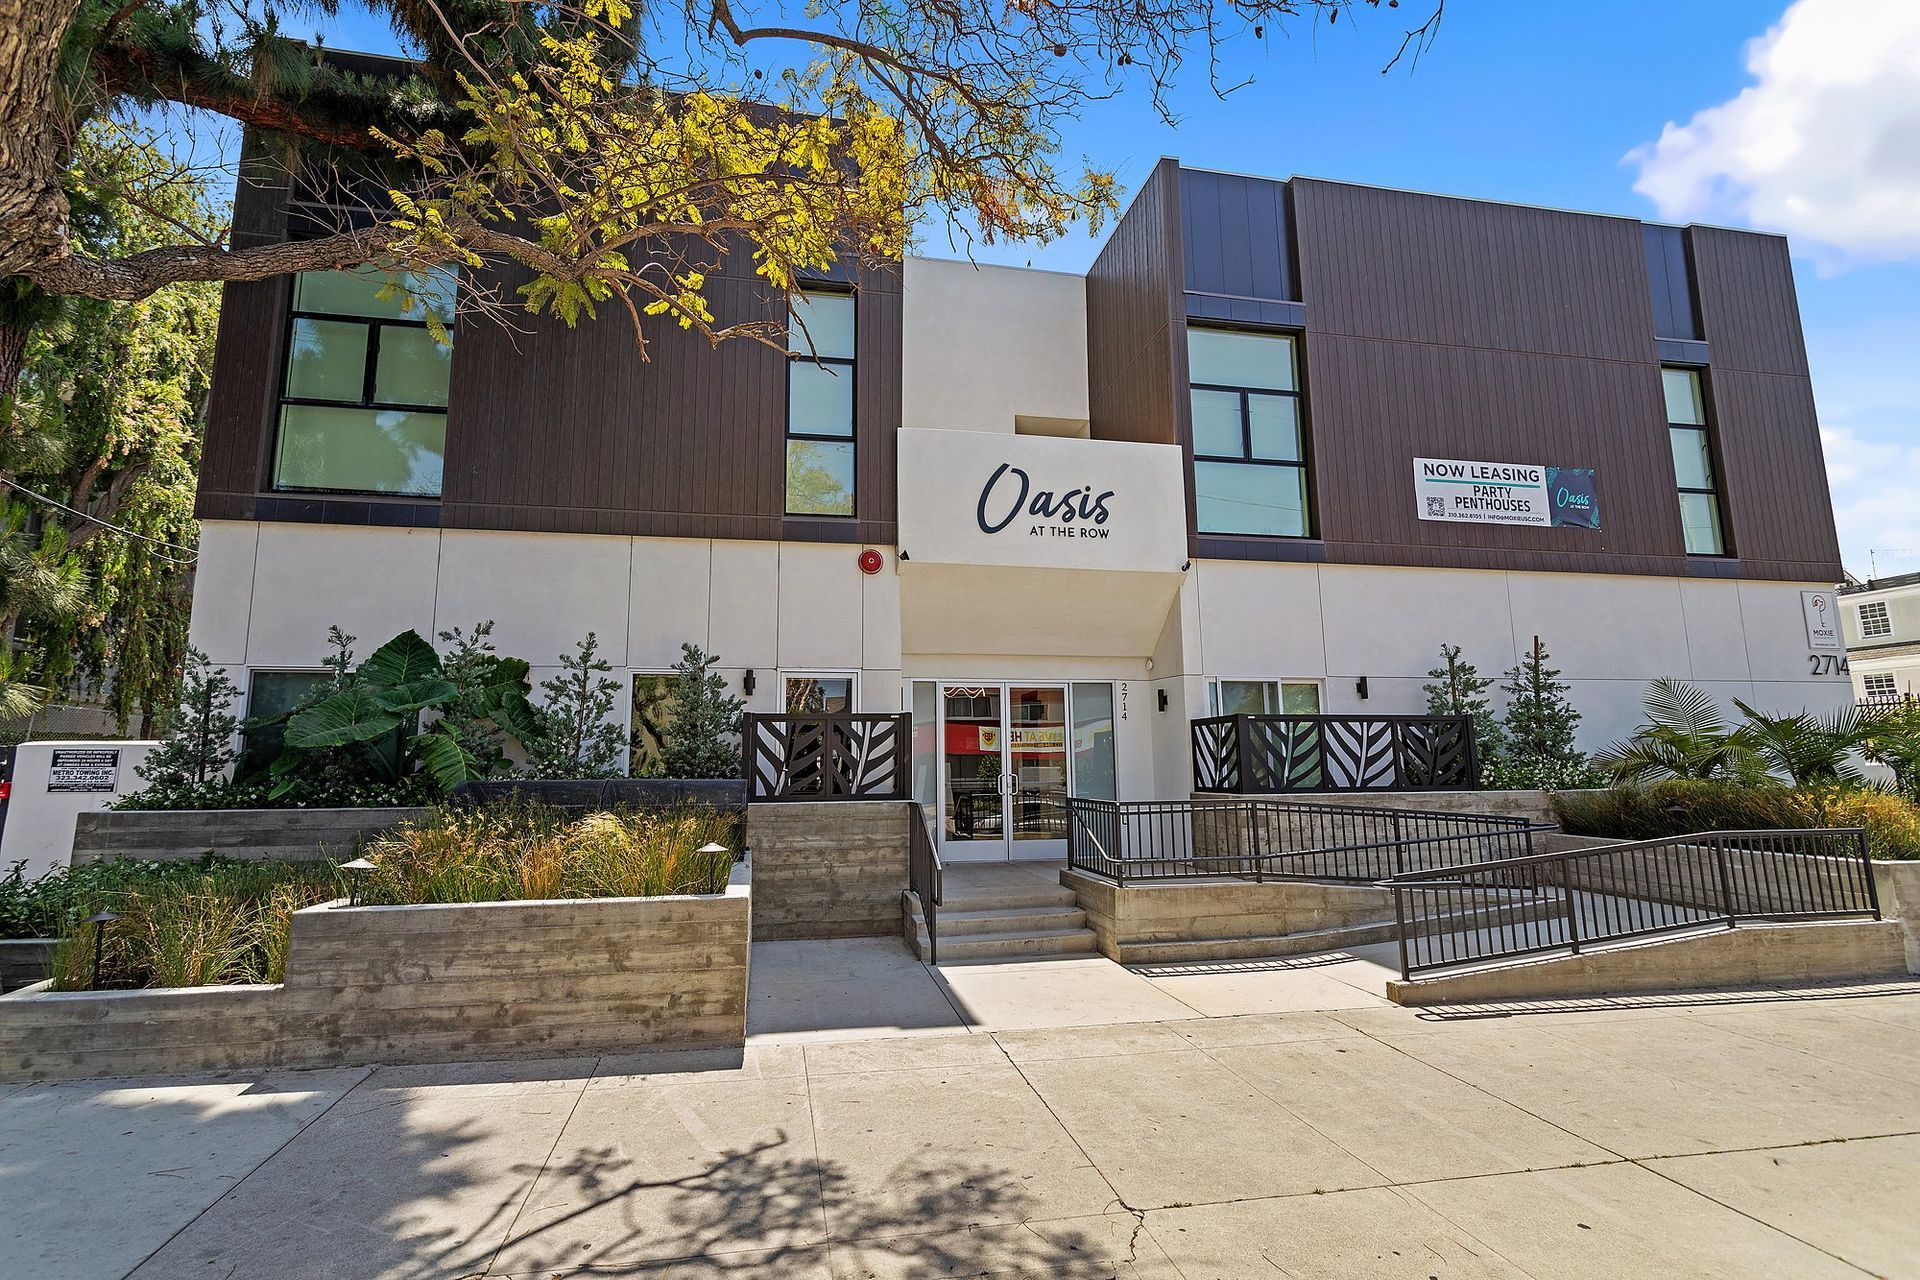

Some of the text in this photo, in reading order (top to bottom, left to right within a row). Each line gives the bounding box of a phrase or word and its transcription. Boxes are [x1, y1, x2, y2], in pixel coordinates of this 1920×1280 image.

[1423, 463, 1540, 482] NOW LEASING
[977, 463, 1115, 534] Oasis
[1473, 485, 1512, 498] PARTY
[1556, 486, 1590, 508] Oasis
[1455, 496, 1531, 512] PENTHOUSES
[1030, 526, 1110, 539] AT THE ROW
[1809, 654, 1850, 676] 2714
